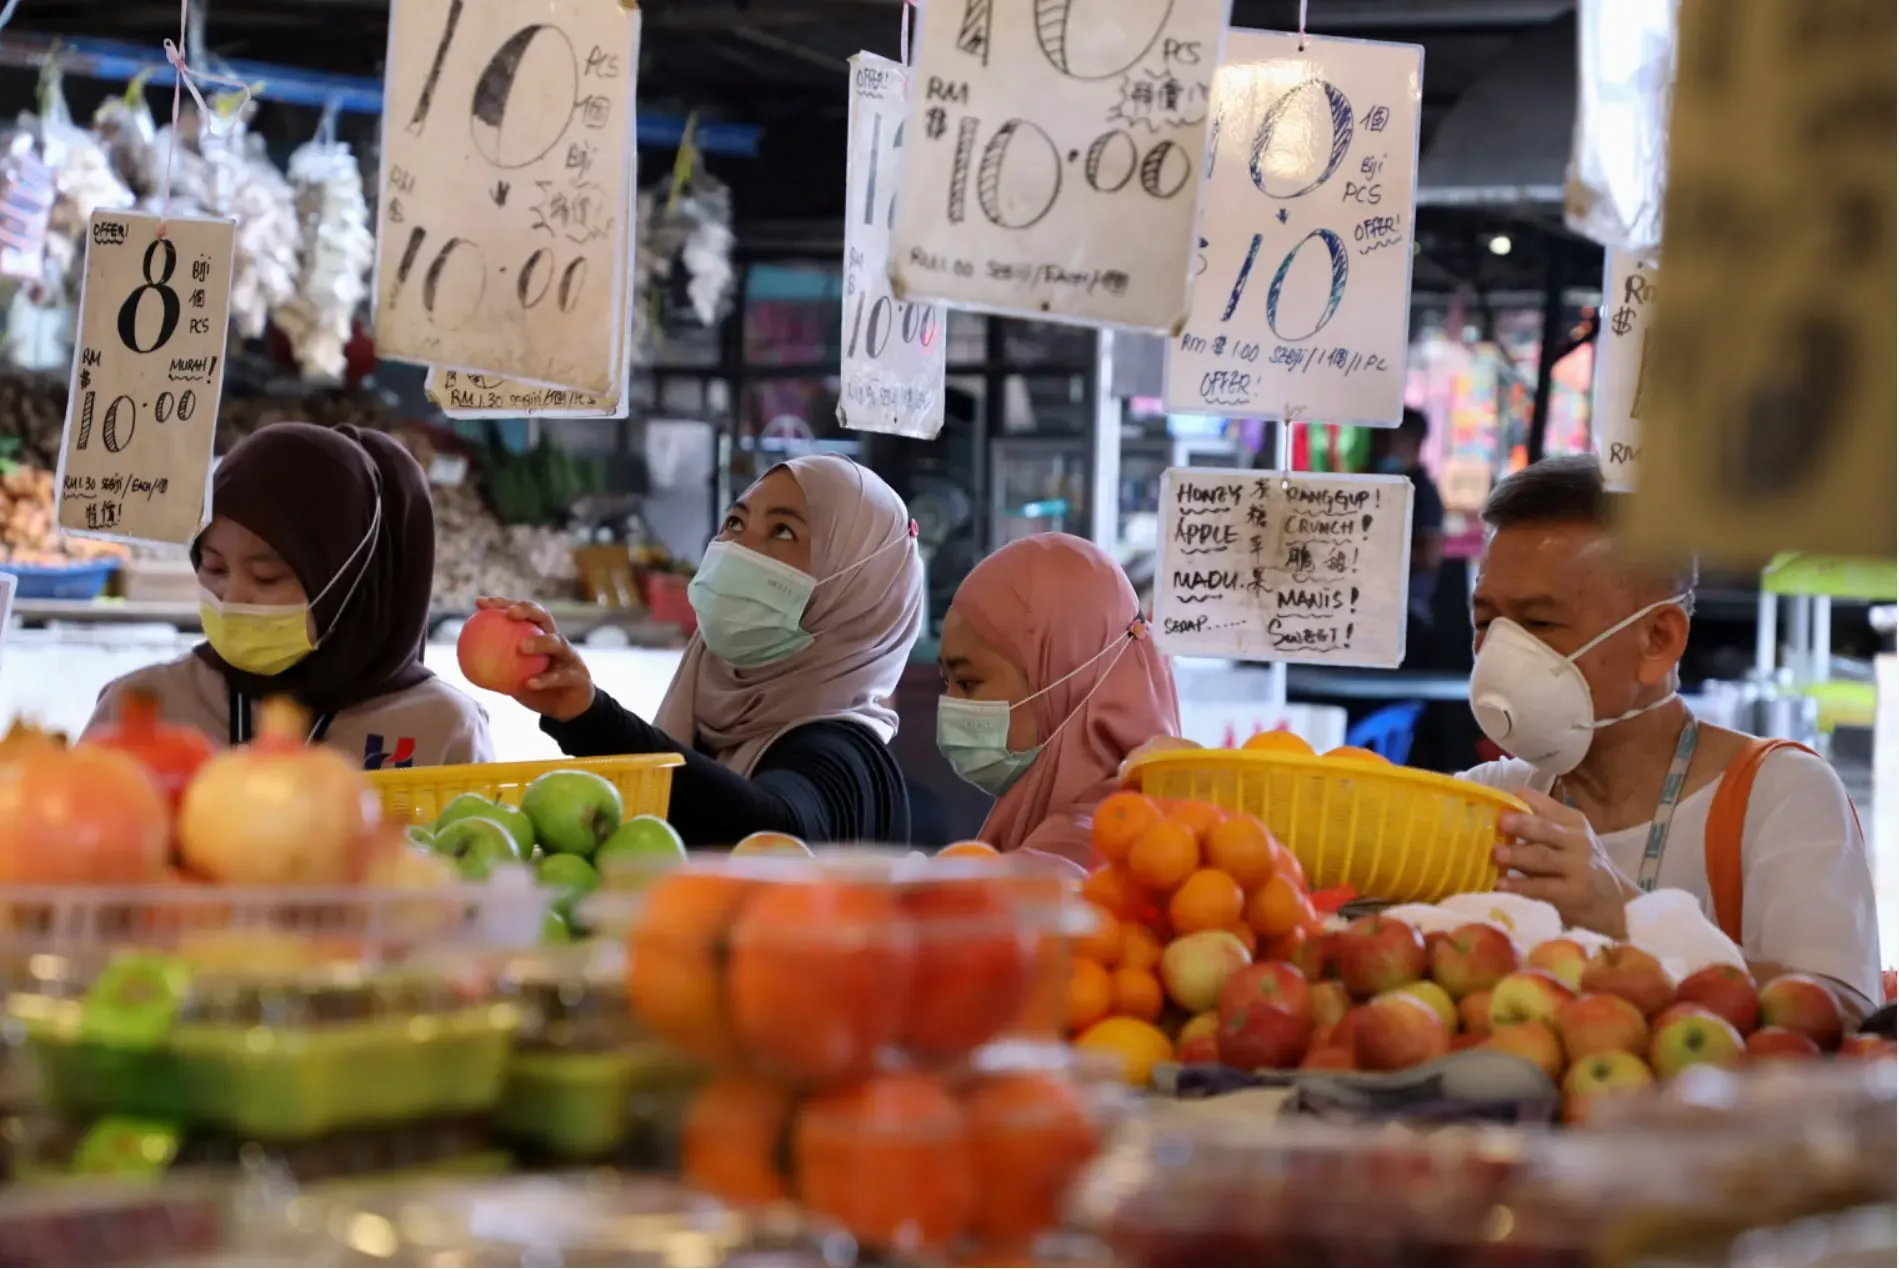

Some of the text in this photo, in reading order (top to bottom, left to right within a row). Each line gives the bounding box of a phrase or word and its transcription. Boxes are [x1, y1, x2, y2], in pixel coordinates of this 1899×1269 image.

[585, 46, 619, 78] PCS
[1164, 38, 1201, 65] PCS
[927, 77, 969, 104] RM
[1342, 182, 1382, 205] PCS
[93, 222, 130, 238] OFFER!
[117, 239, 180, 353] 8
[1221, 229, 1349, 342] 10
[189, 318, 210, 333] PCS
[1611, 306, 1637, 337] $
[82, 348, 101, 367] RM
[170, 356, 217, 384] MURAH!
[1176, 483, 1244, 504] HONEY
[1174, 516, 1239, 545] APPLE
